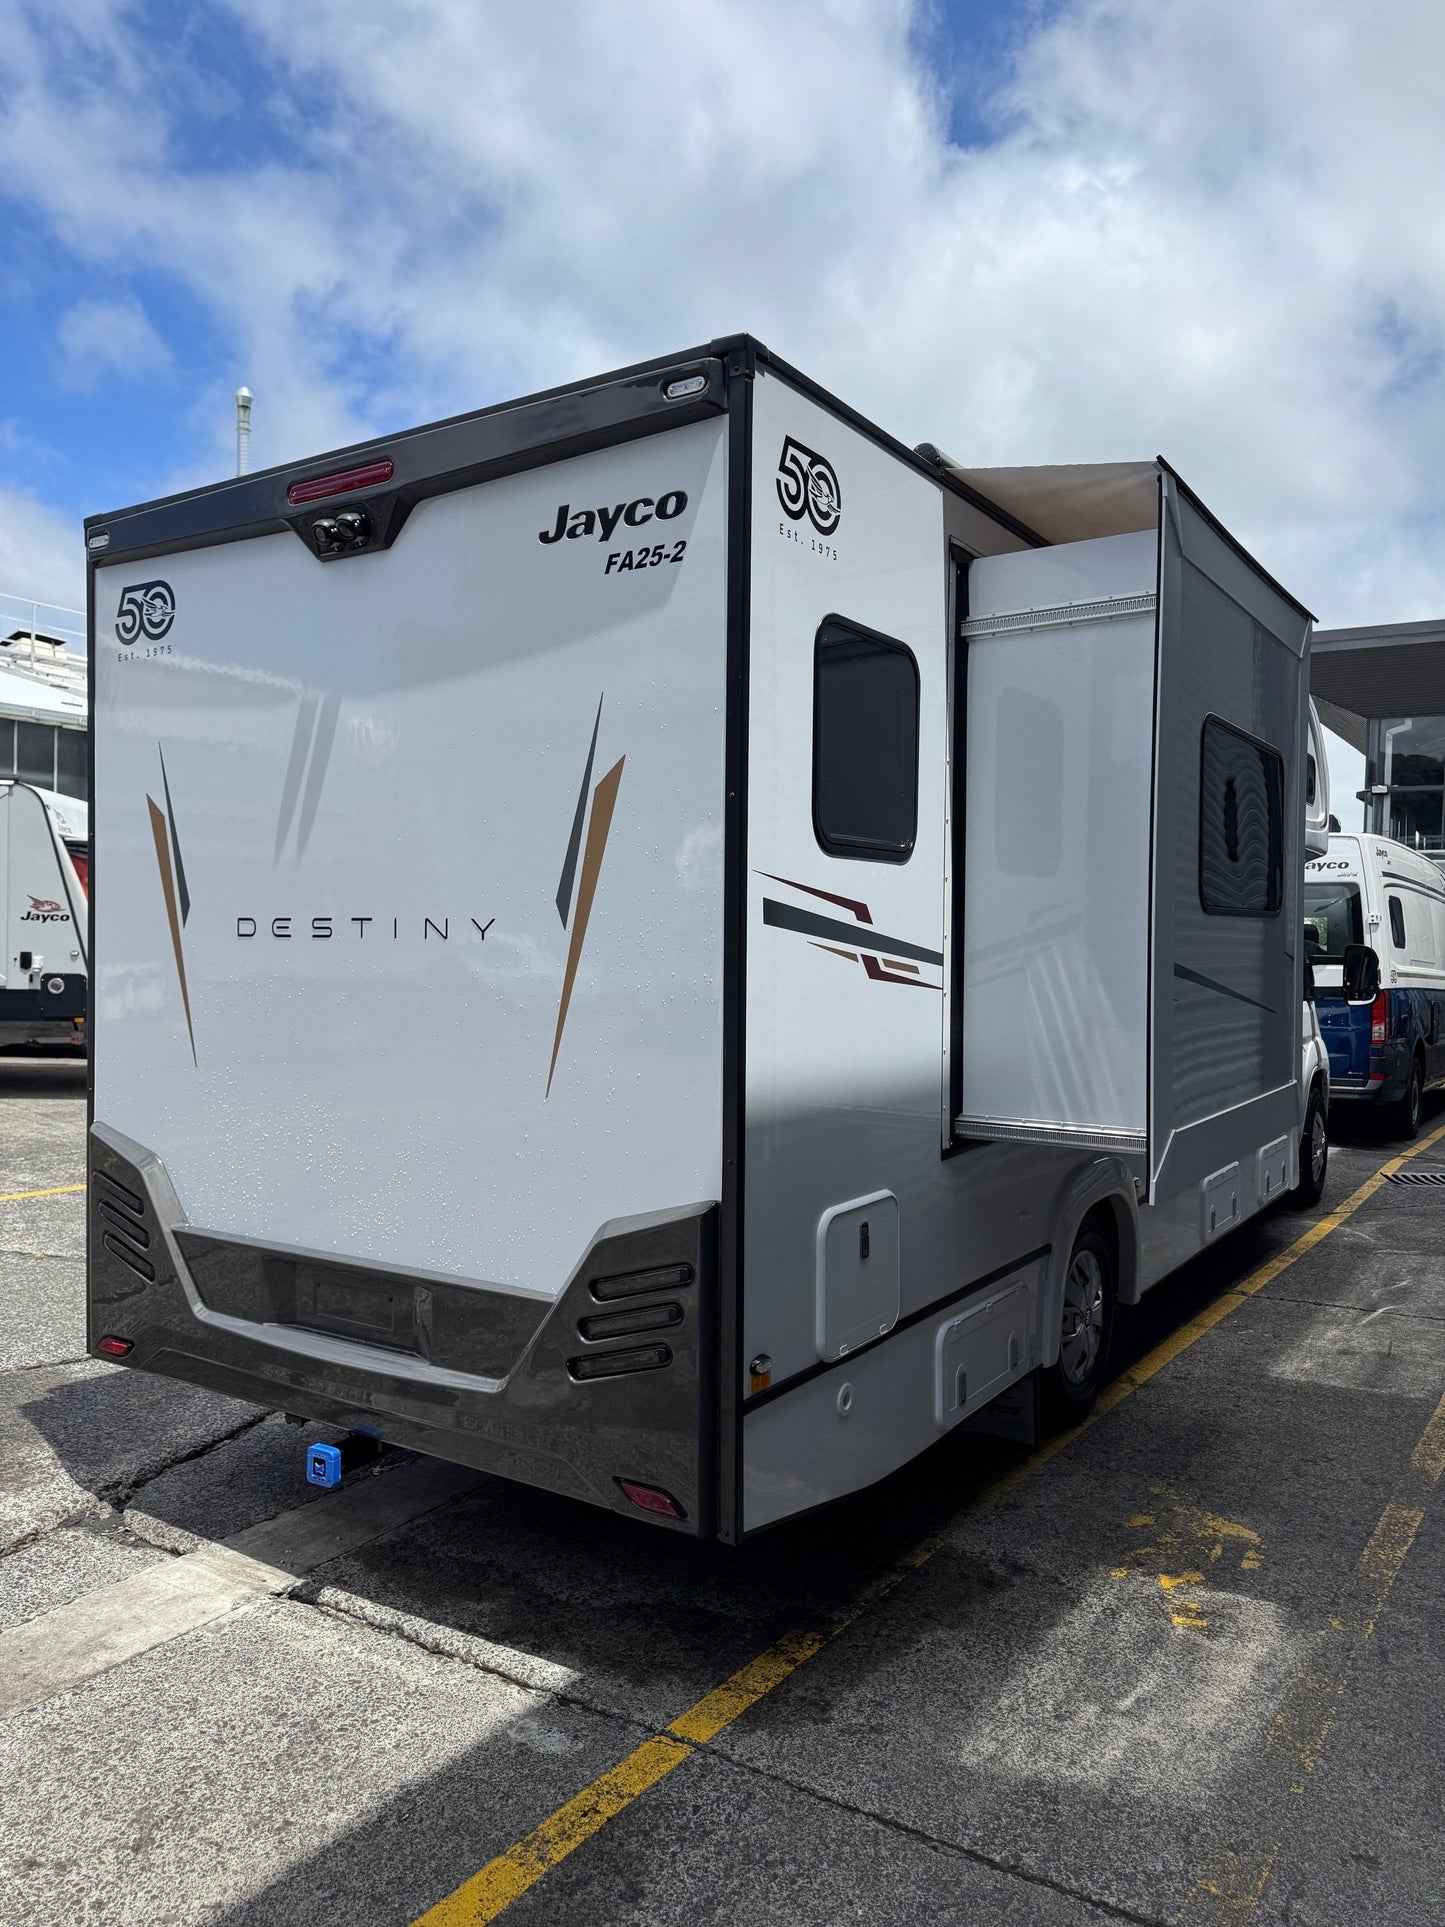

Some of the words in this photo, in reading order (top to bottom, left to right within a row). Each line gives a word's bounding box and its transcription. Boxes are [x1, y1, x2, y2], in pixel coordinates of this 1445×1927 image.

[775, 434, 841, 536] 50
[538, 490, 688, 545] Jayco
[604, 540, 687, 575] FA25-2
[779, 523, 804, 545] Est.
[811, 539, 838, 561] 1975
[115, 579, 176, 646] 50
[117, 651, 140, 662] Est.
[146, 645, 172, 658] 1975
[1305, 861, 1350, 872] ayco
[20, 910, 70, 924] Jayco
[236, 917, 496, 941] DESTINY
